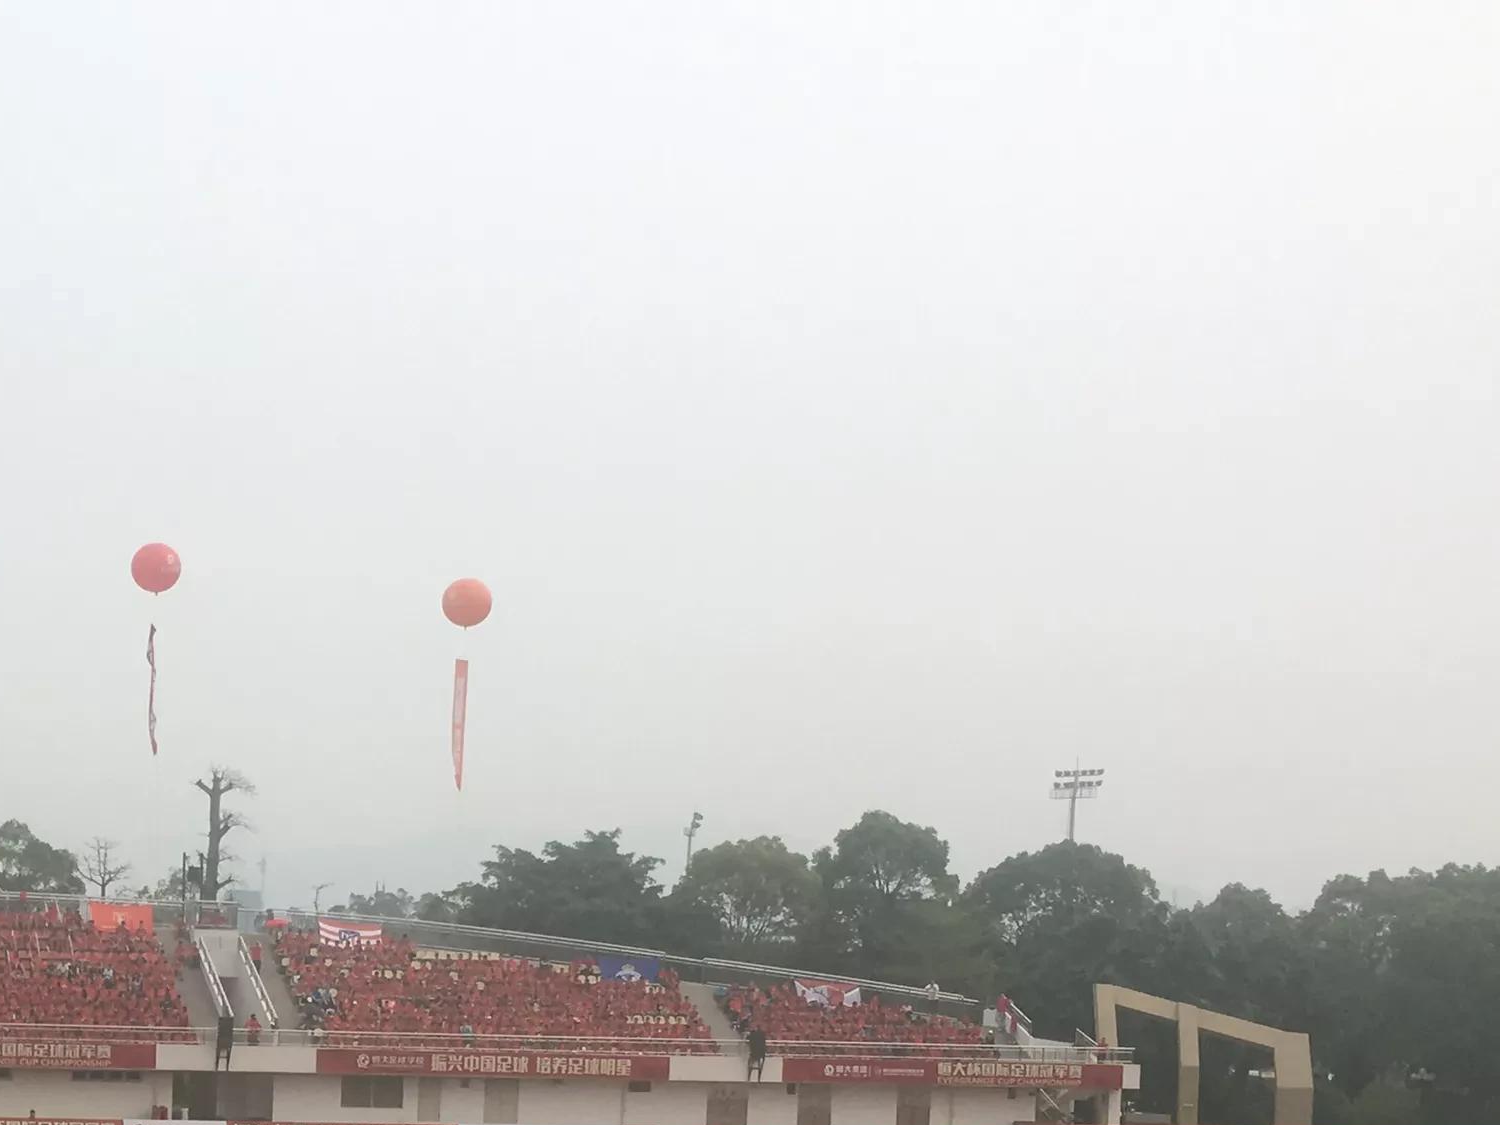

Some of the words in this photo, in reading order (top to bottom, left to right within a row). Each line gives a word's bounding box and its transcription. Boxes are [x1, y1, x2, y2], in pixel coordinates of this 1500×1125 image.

[431, 1054, 529, 1073] 振兴中国足球
[536, 1056, 632, 1076] 培养足球明星
